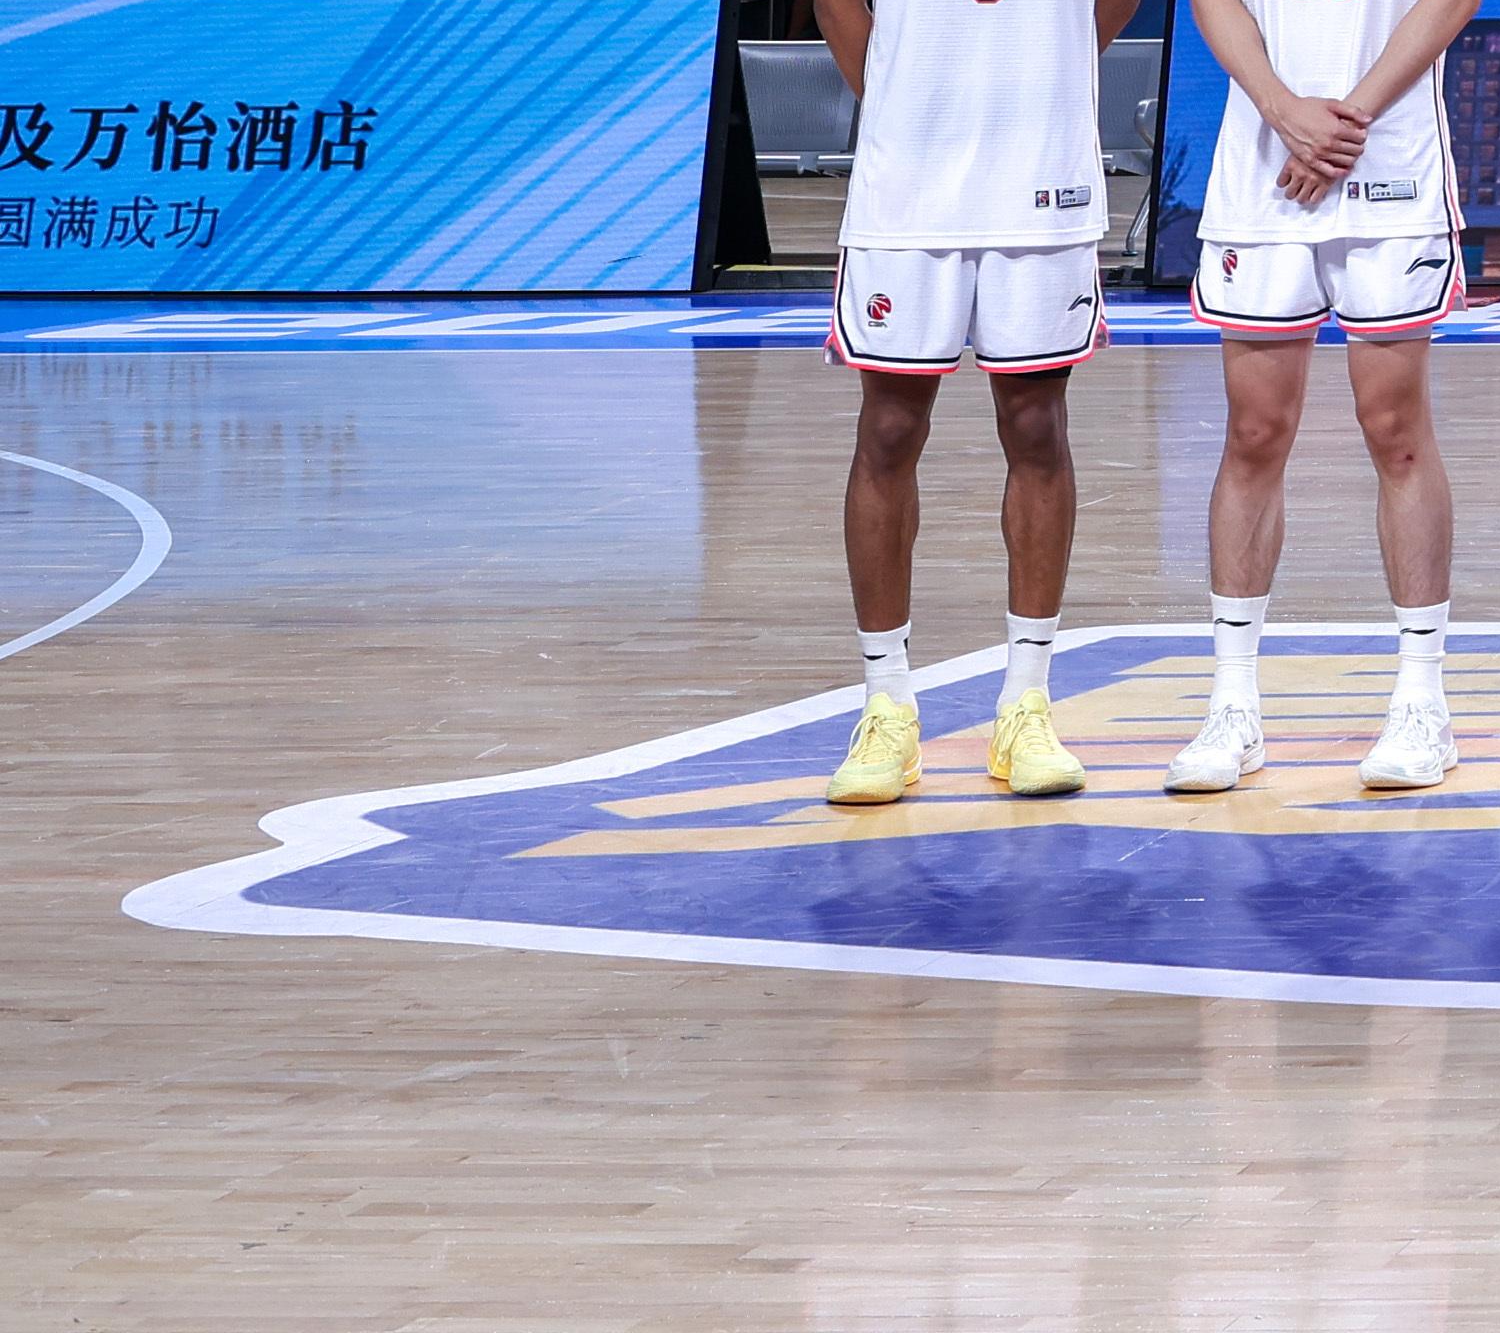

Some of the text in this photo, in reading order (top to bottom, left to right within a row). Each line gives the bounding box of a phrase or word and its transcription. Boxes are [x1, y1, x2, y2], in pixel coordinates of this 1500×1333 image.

[0, 100, 379, 172] 及万怡酒店
[0, 196, 220, 249] 圆满成功
